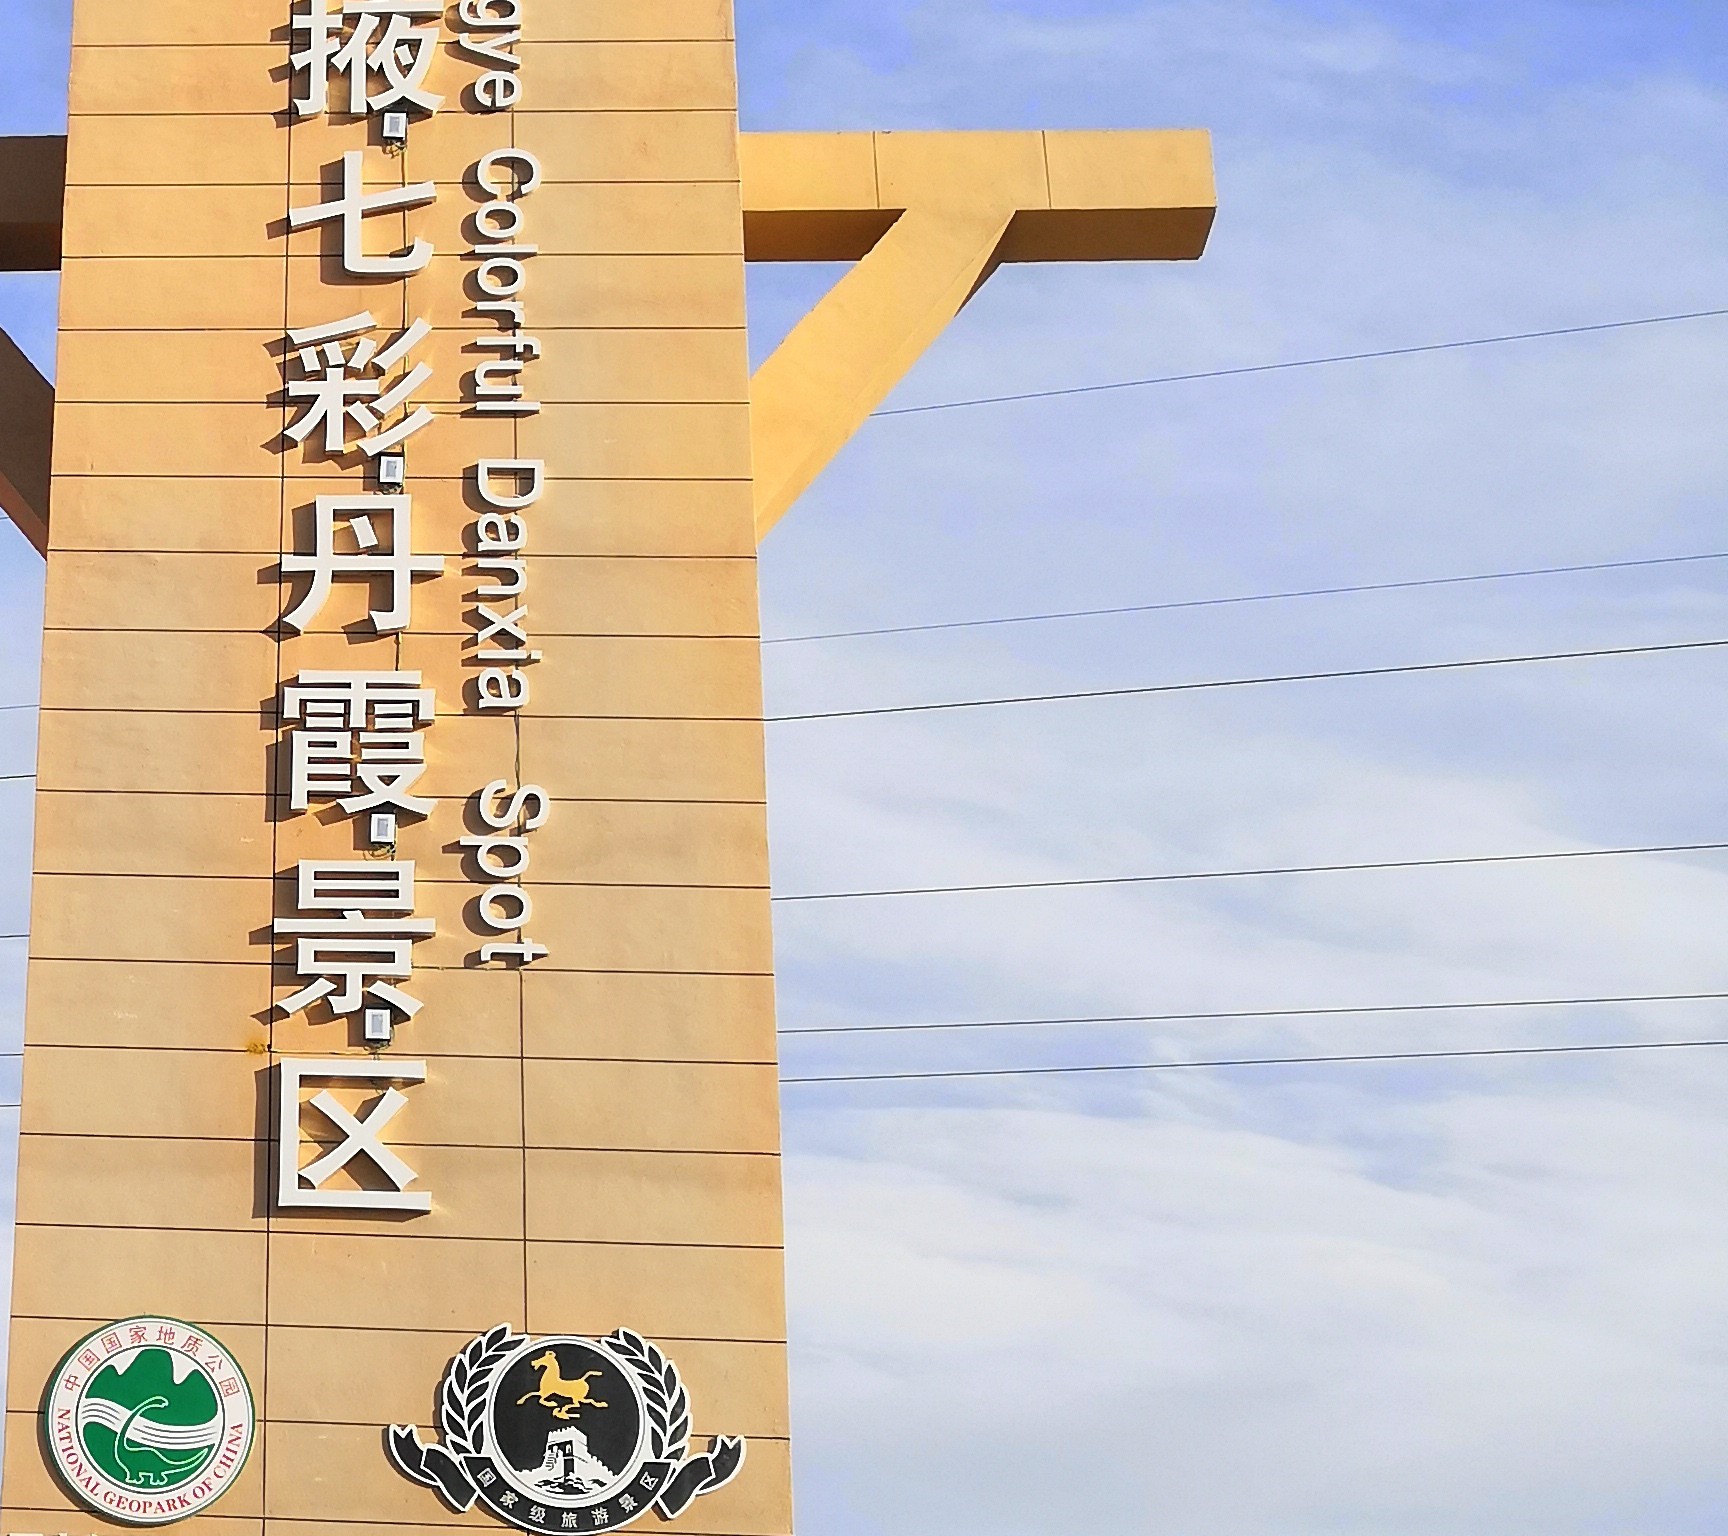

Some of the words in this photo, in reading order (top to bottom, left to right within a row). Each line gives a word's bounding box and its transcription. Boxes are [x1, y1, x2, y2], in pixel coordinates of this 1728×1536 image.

[473, 147, 543, 414] Colorful
[476, 459, 545, 710] Danxia
[459, 779, 551, 964] Spot
[62, 1325, 240, 1398] 中国国家地质公园
[57, 1407, 101, 1497] NATIONAL
[103, 1488, 192, 1515] GEOPARK
[192, 1478, 216, 1500] OF
[212, 1421, 244, 1480] CHINA
